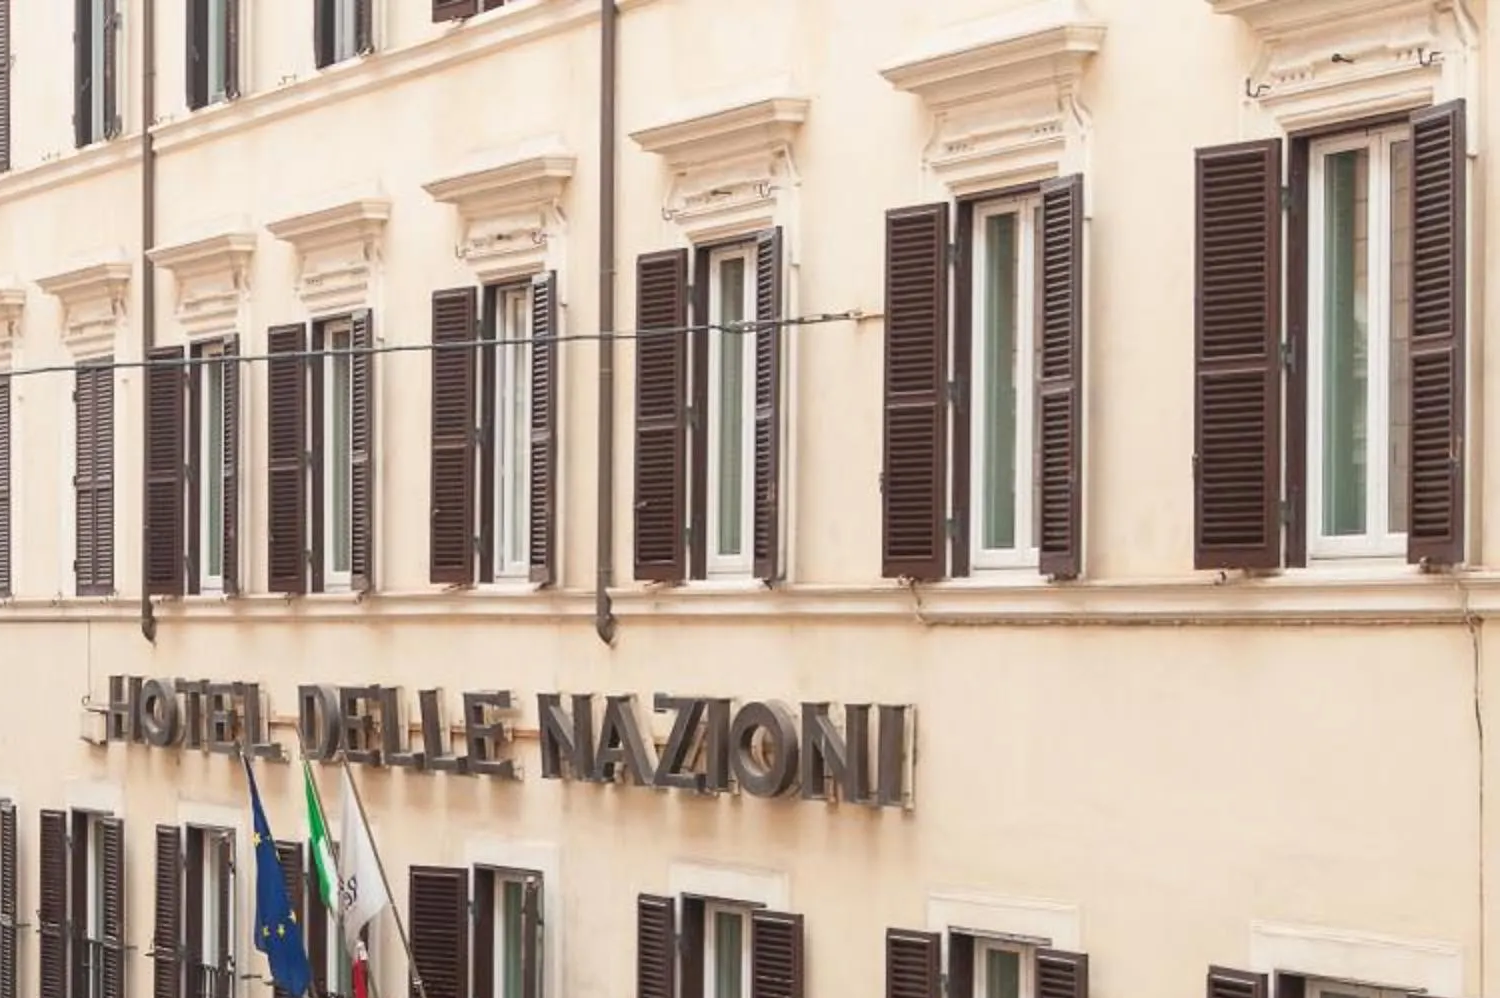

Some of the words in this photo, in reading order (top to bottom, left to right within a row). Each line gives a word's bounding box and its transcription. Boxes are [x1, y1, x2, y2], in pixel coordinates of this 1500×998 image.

[108, 675, 285, 761] HOTEL
[298, 683, 518, 779] DELLE
[537, 693, 913, 810] NAZIONI
